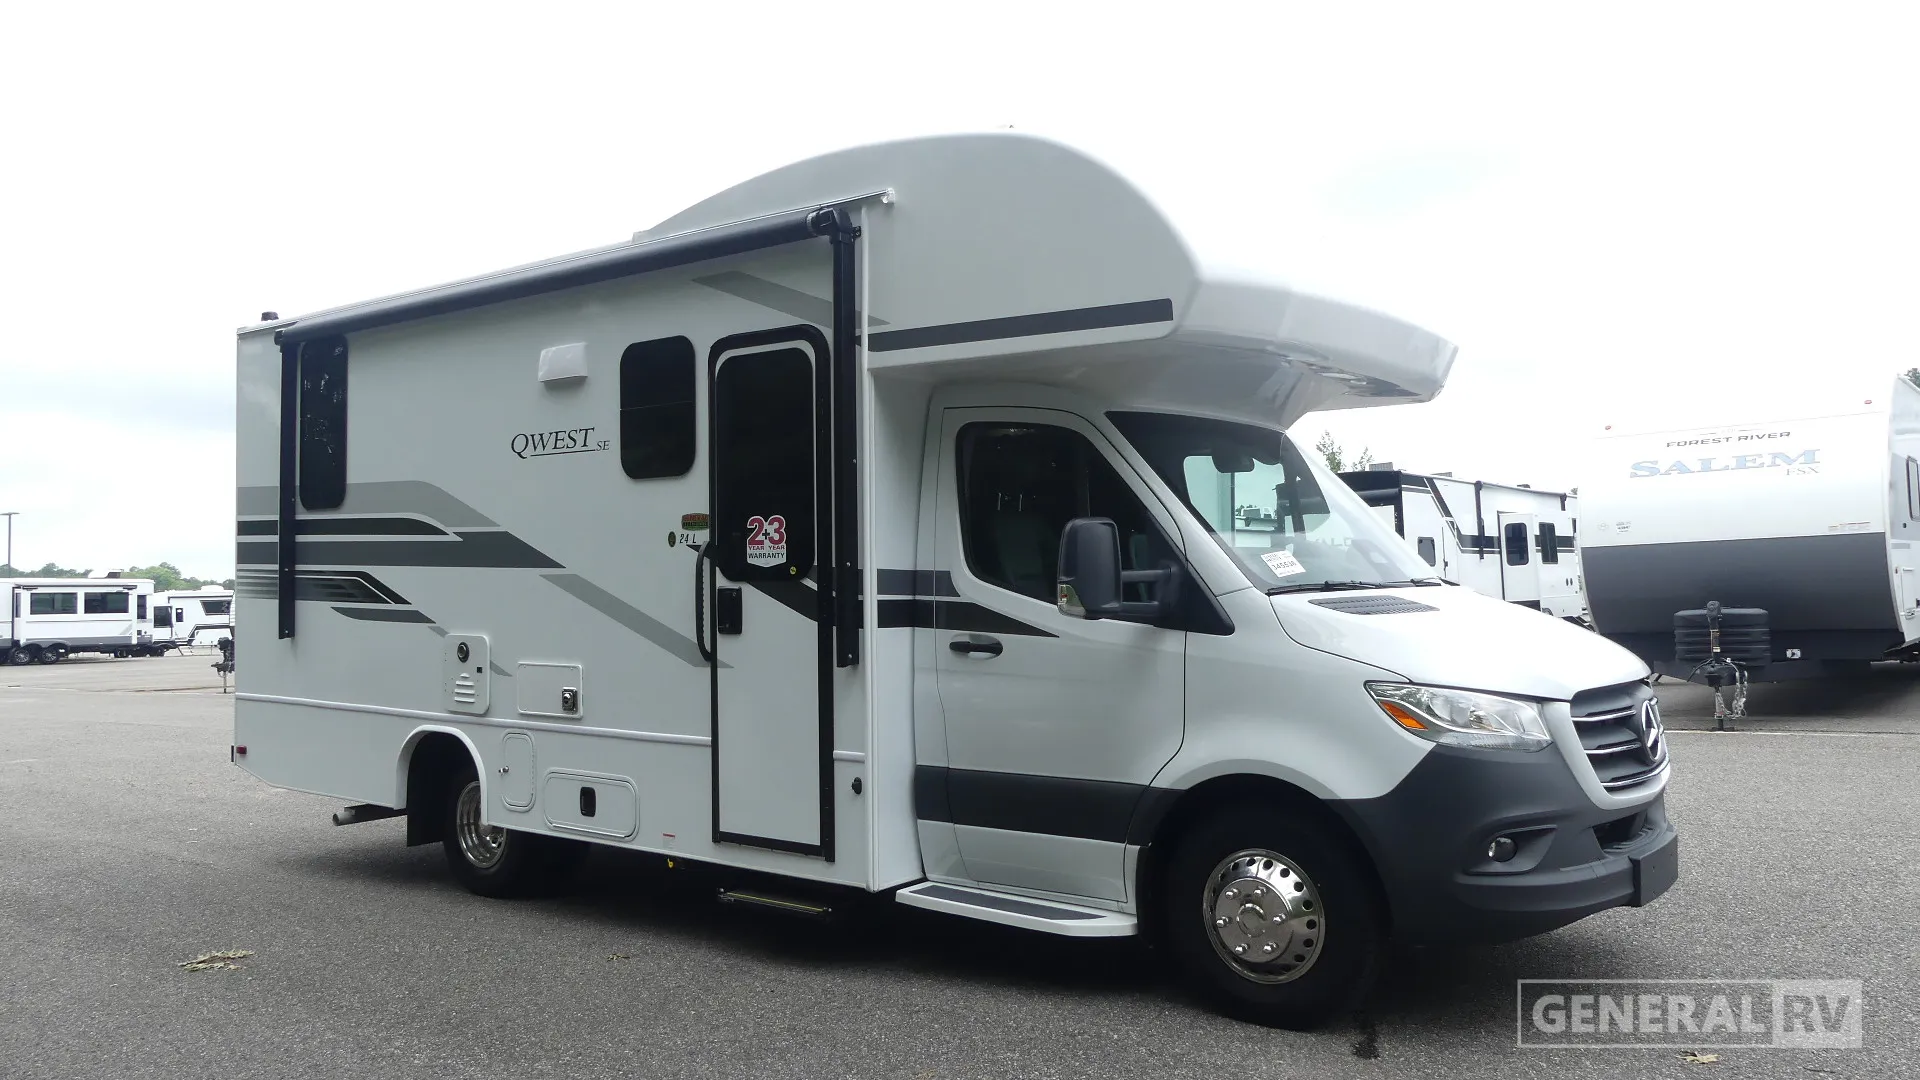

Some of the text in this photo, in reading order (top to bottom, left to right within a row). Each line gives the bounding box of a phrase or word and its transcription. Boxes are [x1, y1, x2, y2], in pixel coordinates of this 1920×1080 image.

[511, 427, 610, 459] QWEST SE
[1667, 431, 1791, 447] FOREST RIVER
[1630, 449, 1821, 478] SALEM
